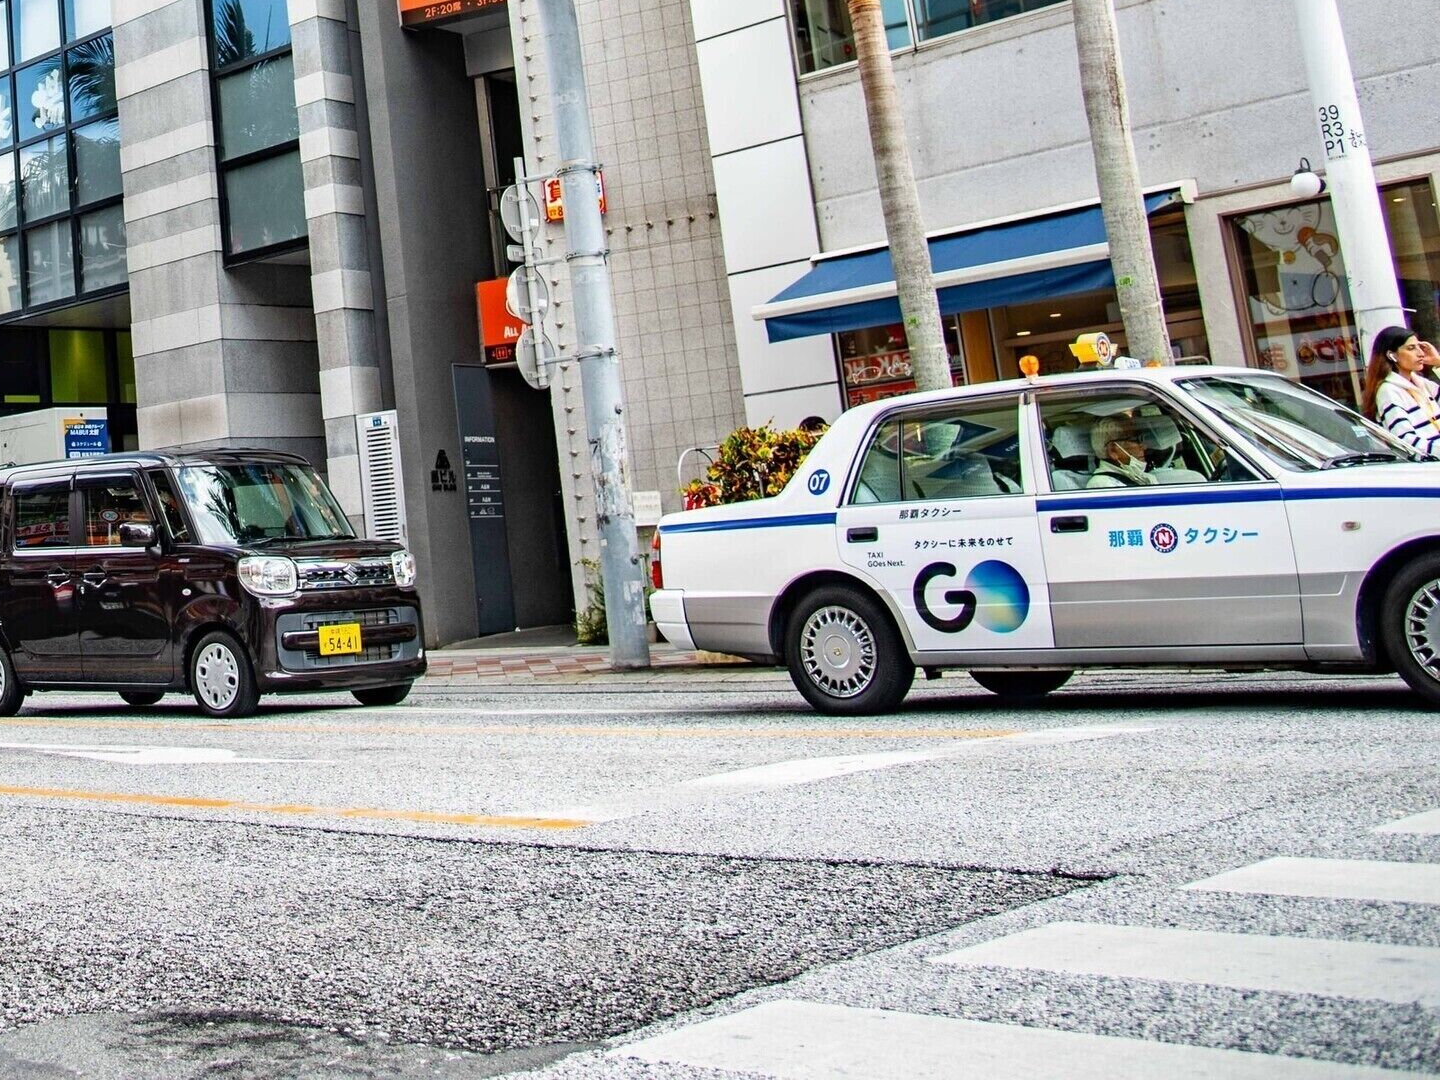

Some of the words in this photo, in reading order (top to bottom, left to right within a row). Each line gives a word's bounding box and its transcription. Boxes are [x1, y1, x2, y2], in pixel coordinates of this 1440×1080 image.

[1318, 104, 1340, 123] 39
[1321, 121, 1345, 139] R3
[1325, 138, 1345, 156] P1
[809, 472, 829, 492] 07
[898, 507, 962, 520] 那覇タクシー
[913, 536, 1015, 551] タクシーに未来をのせて
[1108, 528, 1144, 548] 那覇
[1184, 527, 1259, 545] タクシー
[867, 551, 885, 559] TAXI
[912, 559, 1031, 634] GO
